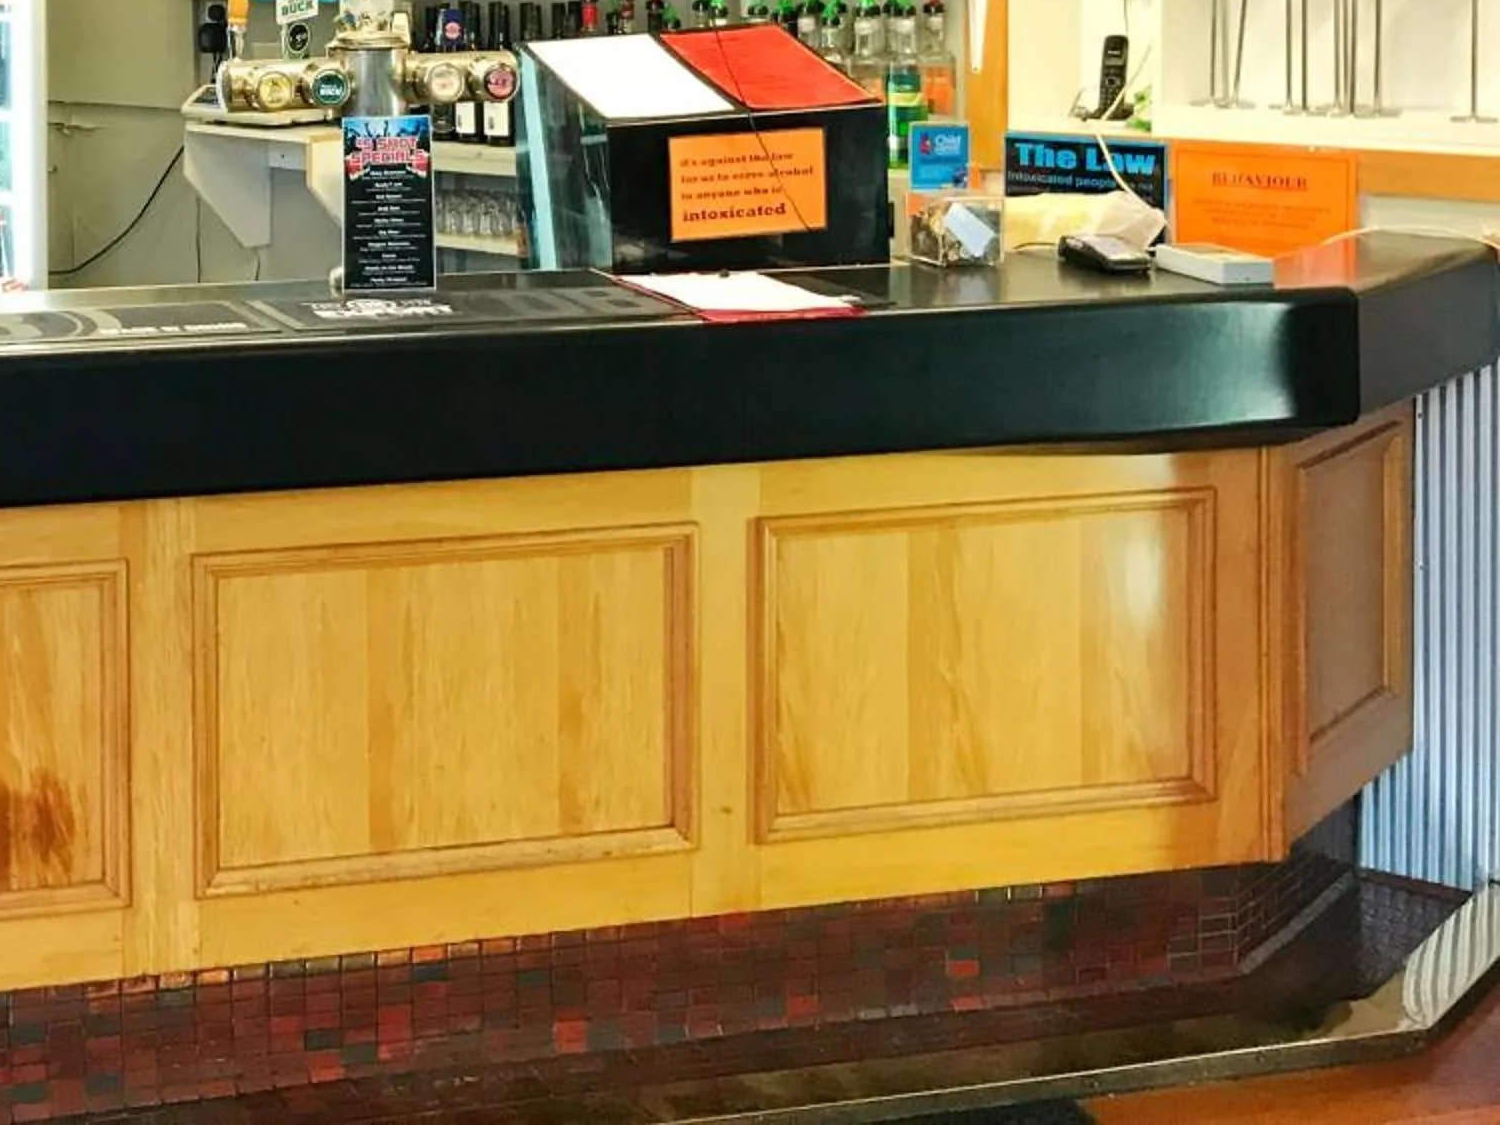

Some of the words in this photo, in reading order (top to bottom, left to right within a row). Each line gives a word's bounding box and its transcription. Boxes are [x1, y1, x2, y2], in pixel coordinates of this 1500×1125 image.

[281, 0, 314, 16] BUCK
[350, 150, 426, 165] SPECIALS
[701, 154, 746, 168] against
[1014, 142, 1077, 169] The
[1085, 147, 1156, 174] Law
[717, 173, 730, 182] to
[1007, 171, 1072, 186] Intoxicated
[1211, 171, 1308, 189] BEHAVIOUR
[696, 189, 740, 201] anyone
[683, 202, 787, 223] intoxicated
